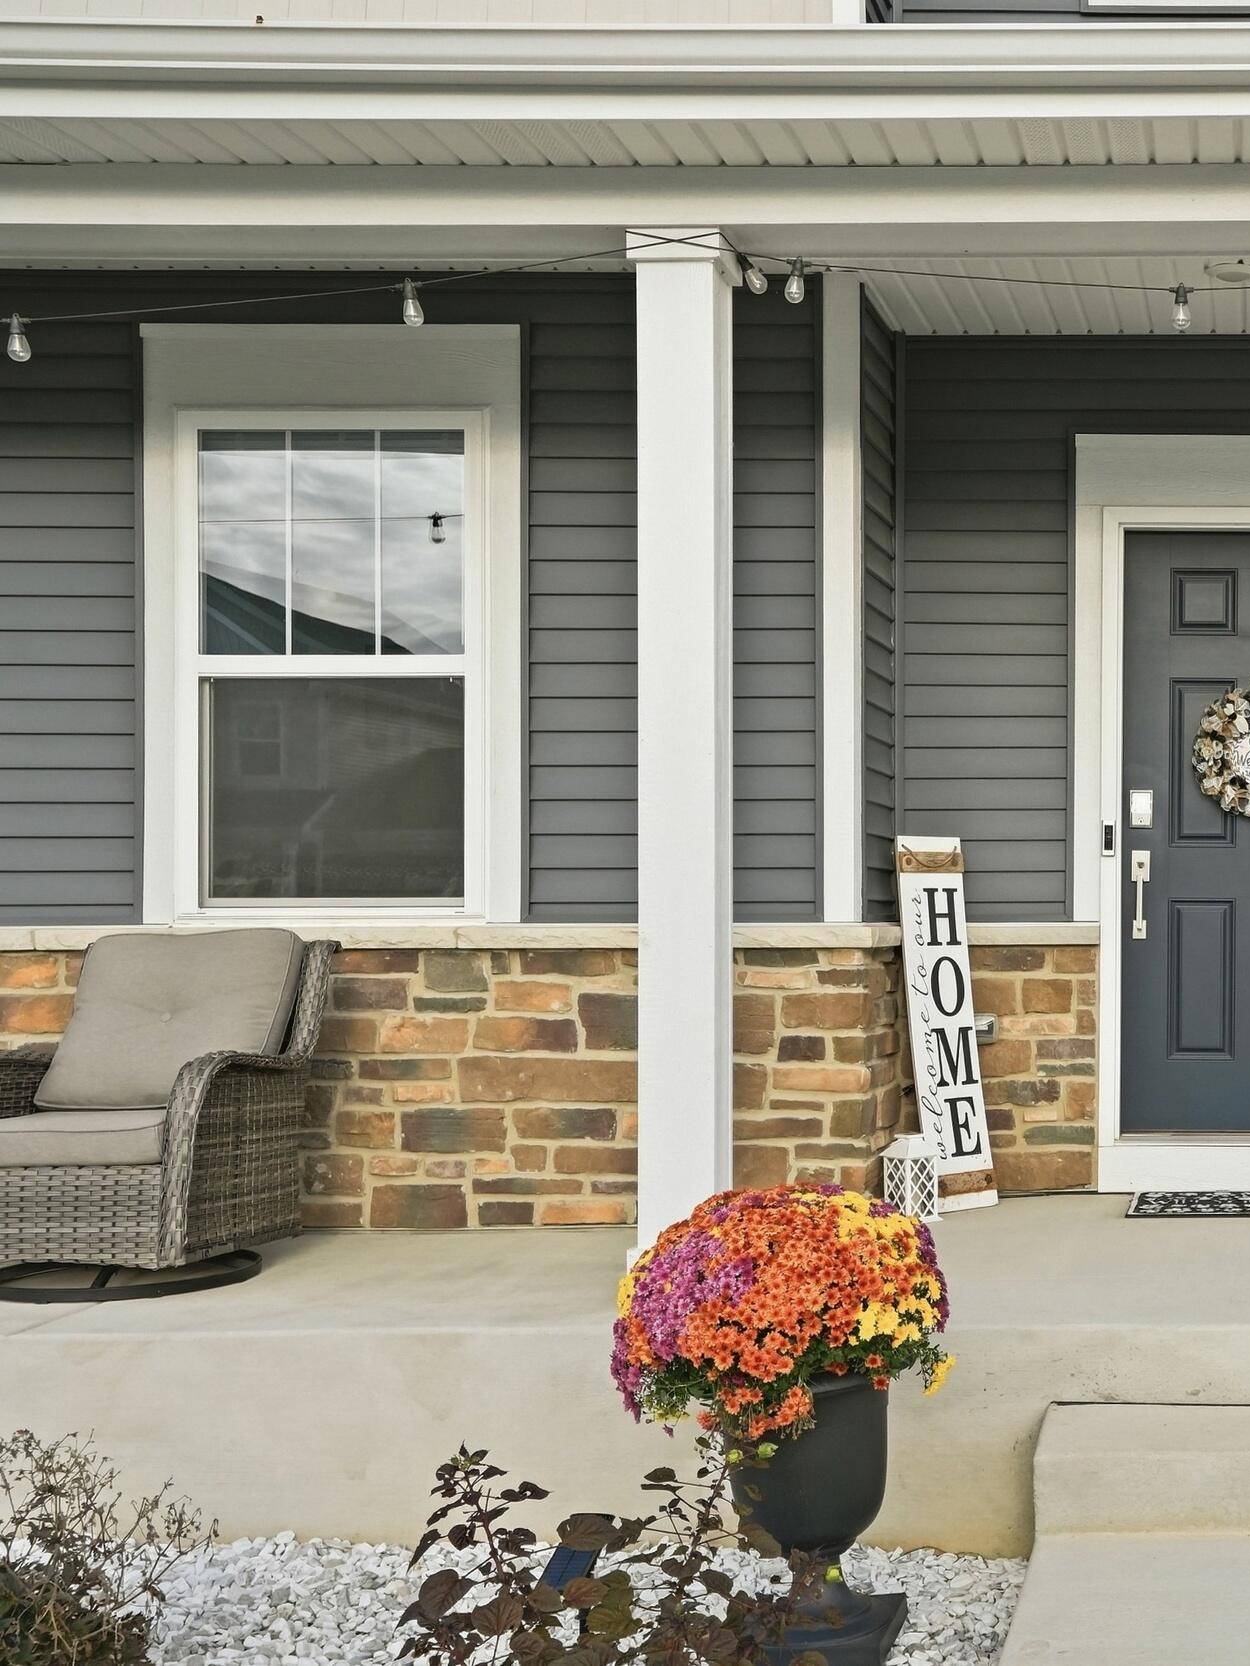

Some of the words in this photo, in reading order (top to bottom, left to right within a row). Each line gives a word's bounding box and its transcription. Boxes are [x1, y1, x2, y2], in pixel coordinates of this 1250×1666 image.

[911, 888, 925, 947] our
[911, 952, 929, 996] to
[923, 888, 982, 1157] HOME
[920, 1003, 947, 1160] welcome
